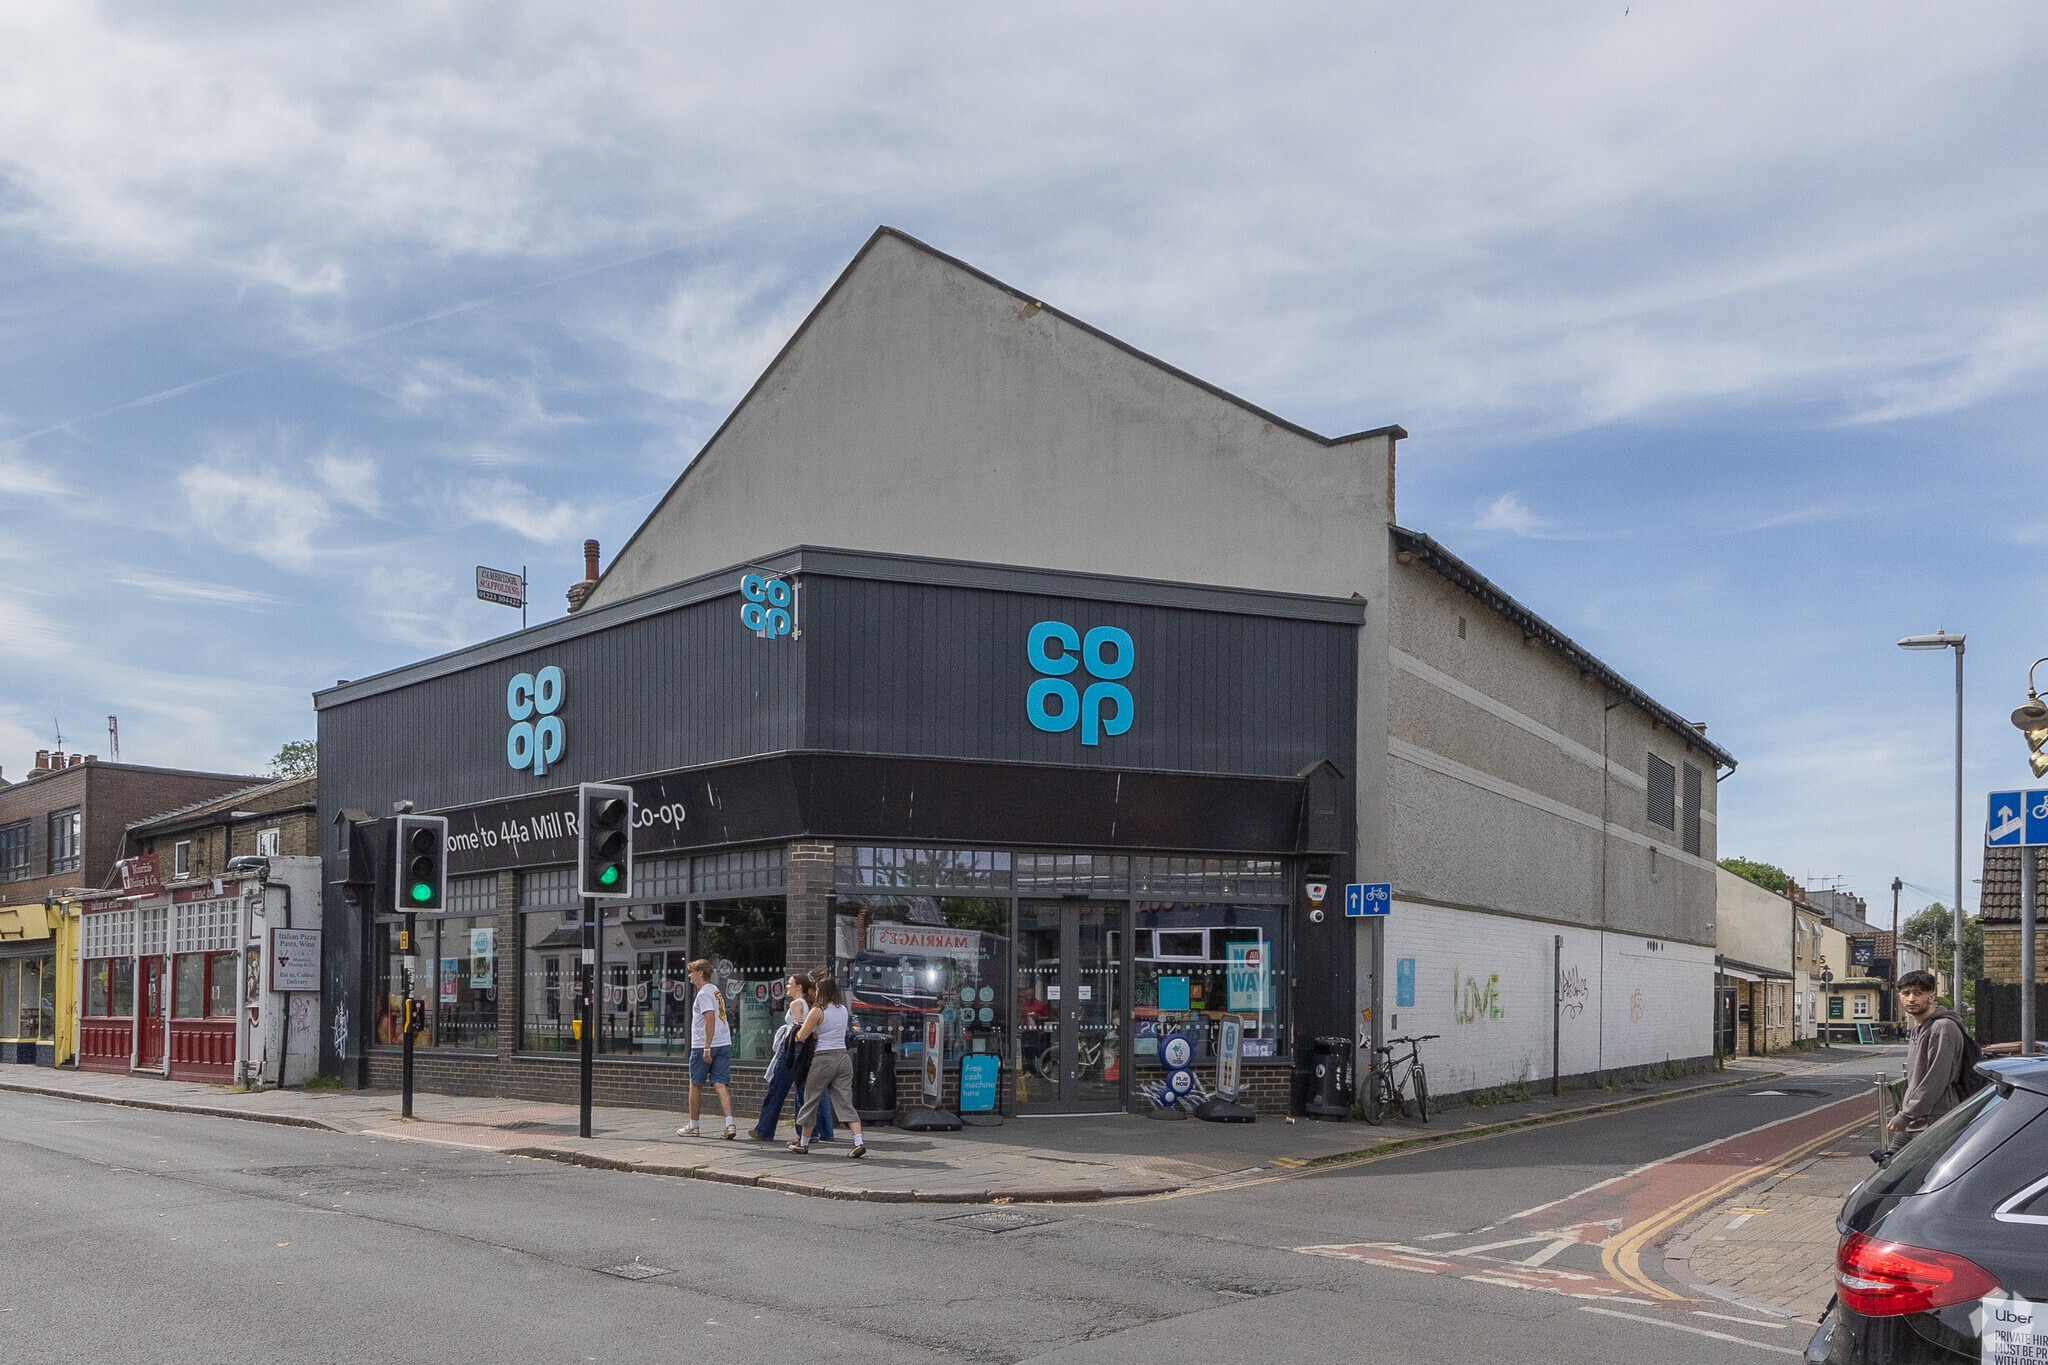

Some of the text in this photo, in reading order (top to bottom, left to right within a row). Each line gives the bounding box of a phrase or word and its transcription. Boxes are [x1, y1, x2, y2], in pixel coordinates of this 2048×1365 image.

[479, 579, 520, 596] SCAFFOLDING
[479, 591, 497, 601] 01223
[480, 827, 498, 848] to
[501, 820, 530, 846] 44a
[531, 811, 564, 840] Mill
[299, 940, 316, 948] Wine
[300, 933, 317, 941] Pizza
[1230, 972, 1267, 993] WAY
[965, 1064, 982, 1072] Free
[1995, 1309, 2034, 1324] Uber
[1995, 1330, 2031, 1345] PRIVATE
[1995, 1343, 2021, 1356] MUST
[2022, 1345, 2034, 1358] BE
[1994, 1355, 2018, 1365] WITH
